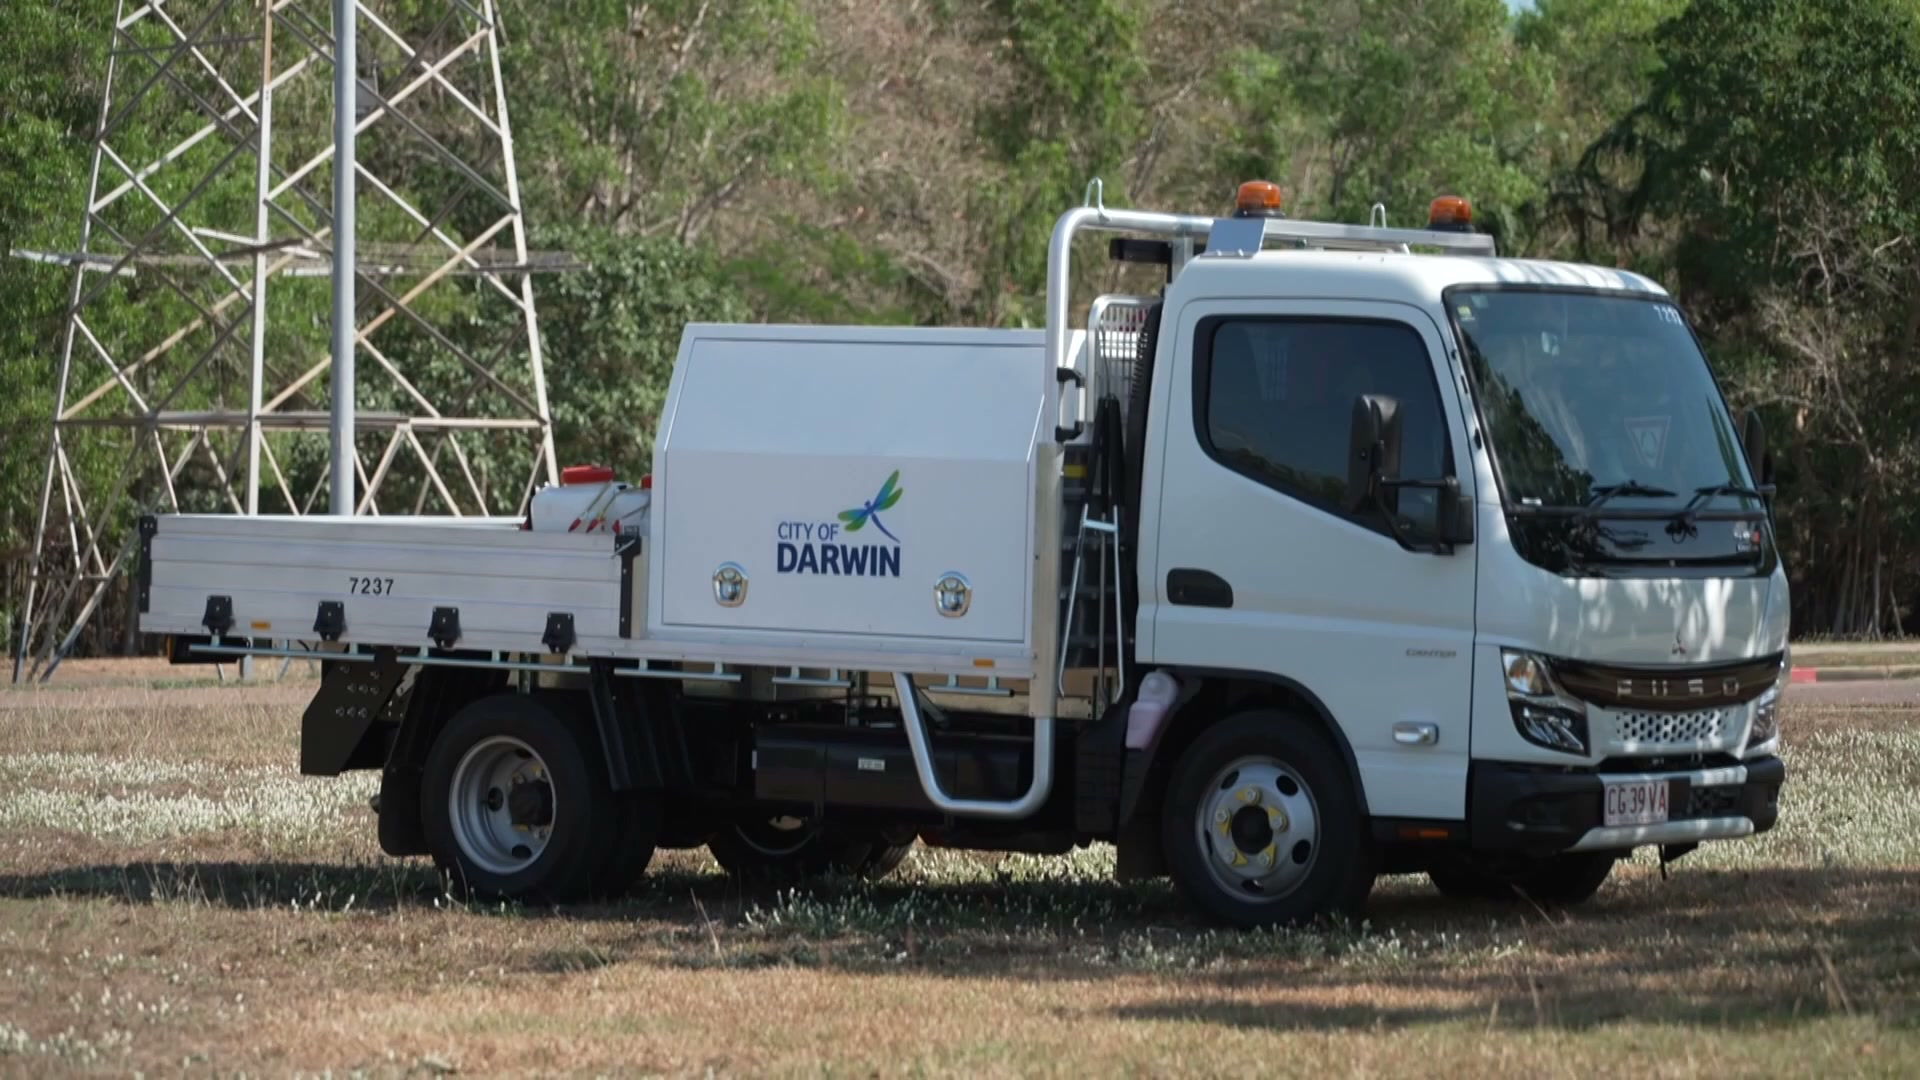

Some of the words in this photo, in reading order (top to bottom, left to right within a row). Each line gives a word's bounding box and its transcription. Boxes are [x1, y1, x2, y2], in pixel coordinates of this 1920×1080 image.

[778, 521, 814, 541] CITY
[818, 523, 839, 541] OF
[777, 542, 901, 577] DARWIN
[349, 576, 394, 596] 7237
[1617, 678, 1740, 697] FUSO
